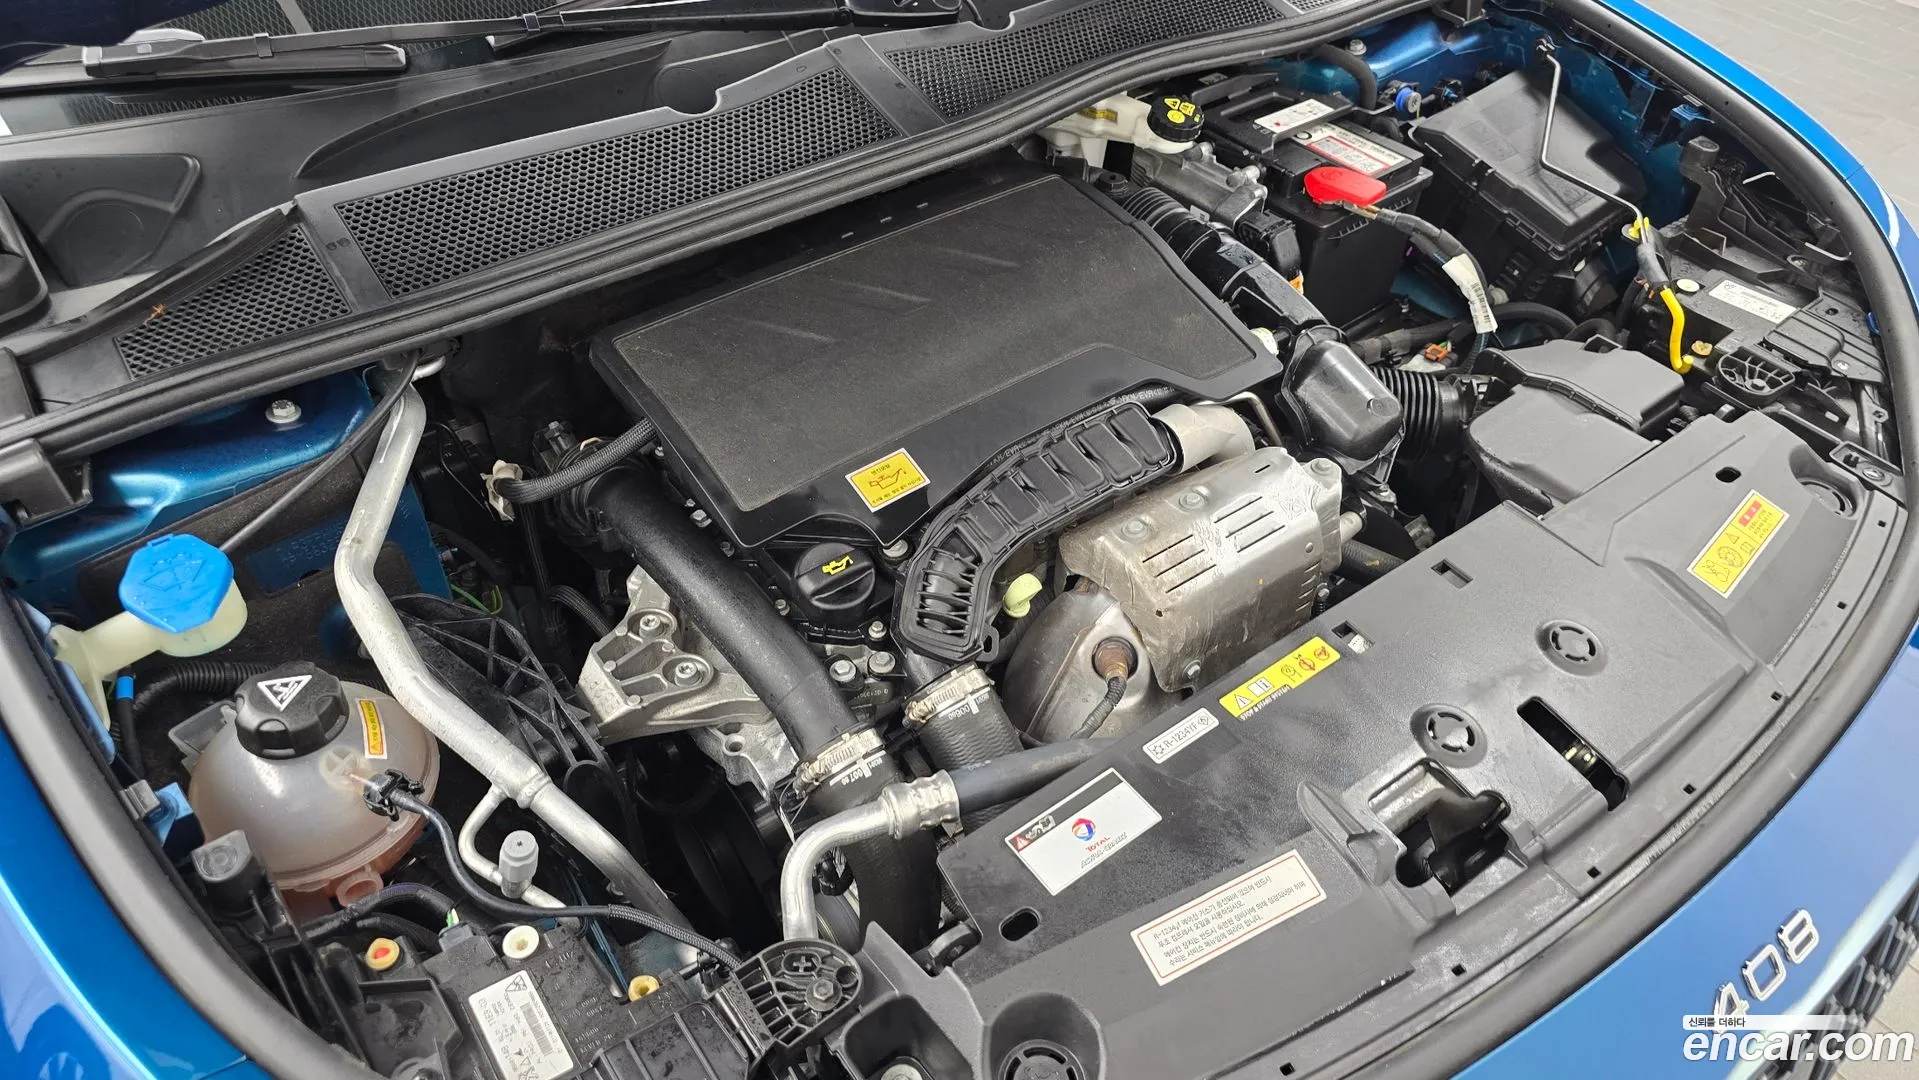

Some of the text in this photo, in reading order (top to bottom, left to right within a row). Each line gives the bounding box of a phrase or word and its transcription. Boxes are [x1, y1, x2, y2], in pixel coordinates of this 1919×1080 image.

[1163, 722, 1198, 748] R-1234YF
[1085, 836, 1111, 852] TOTAL
[1187, 945, 1204, 957] 서비스
[1713, 909, 1820, 1034] 408
